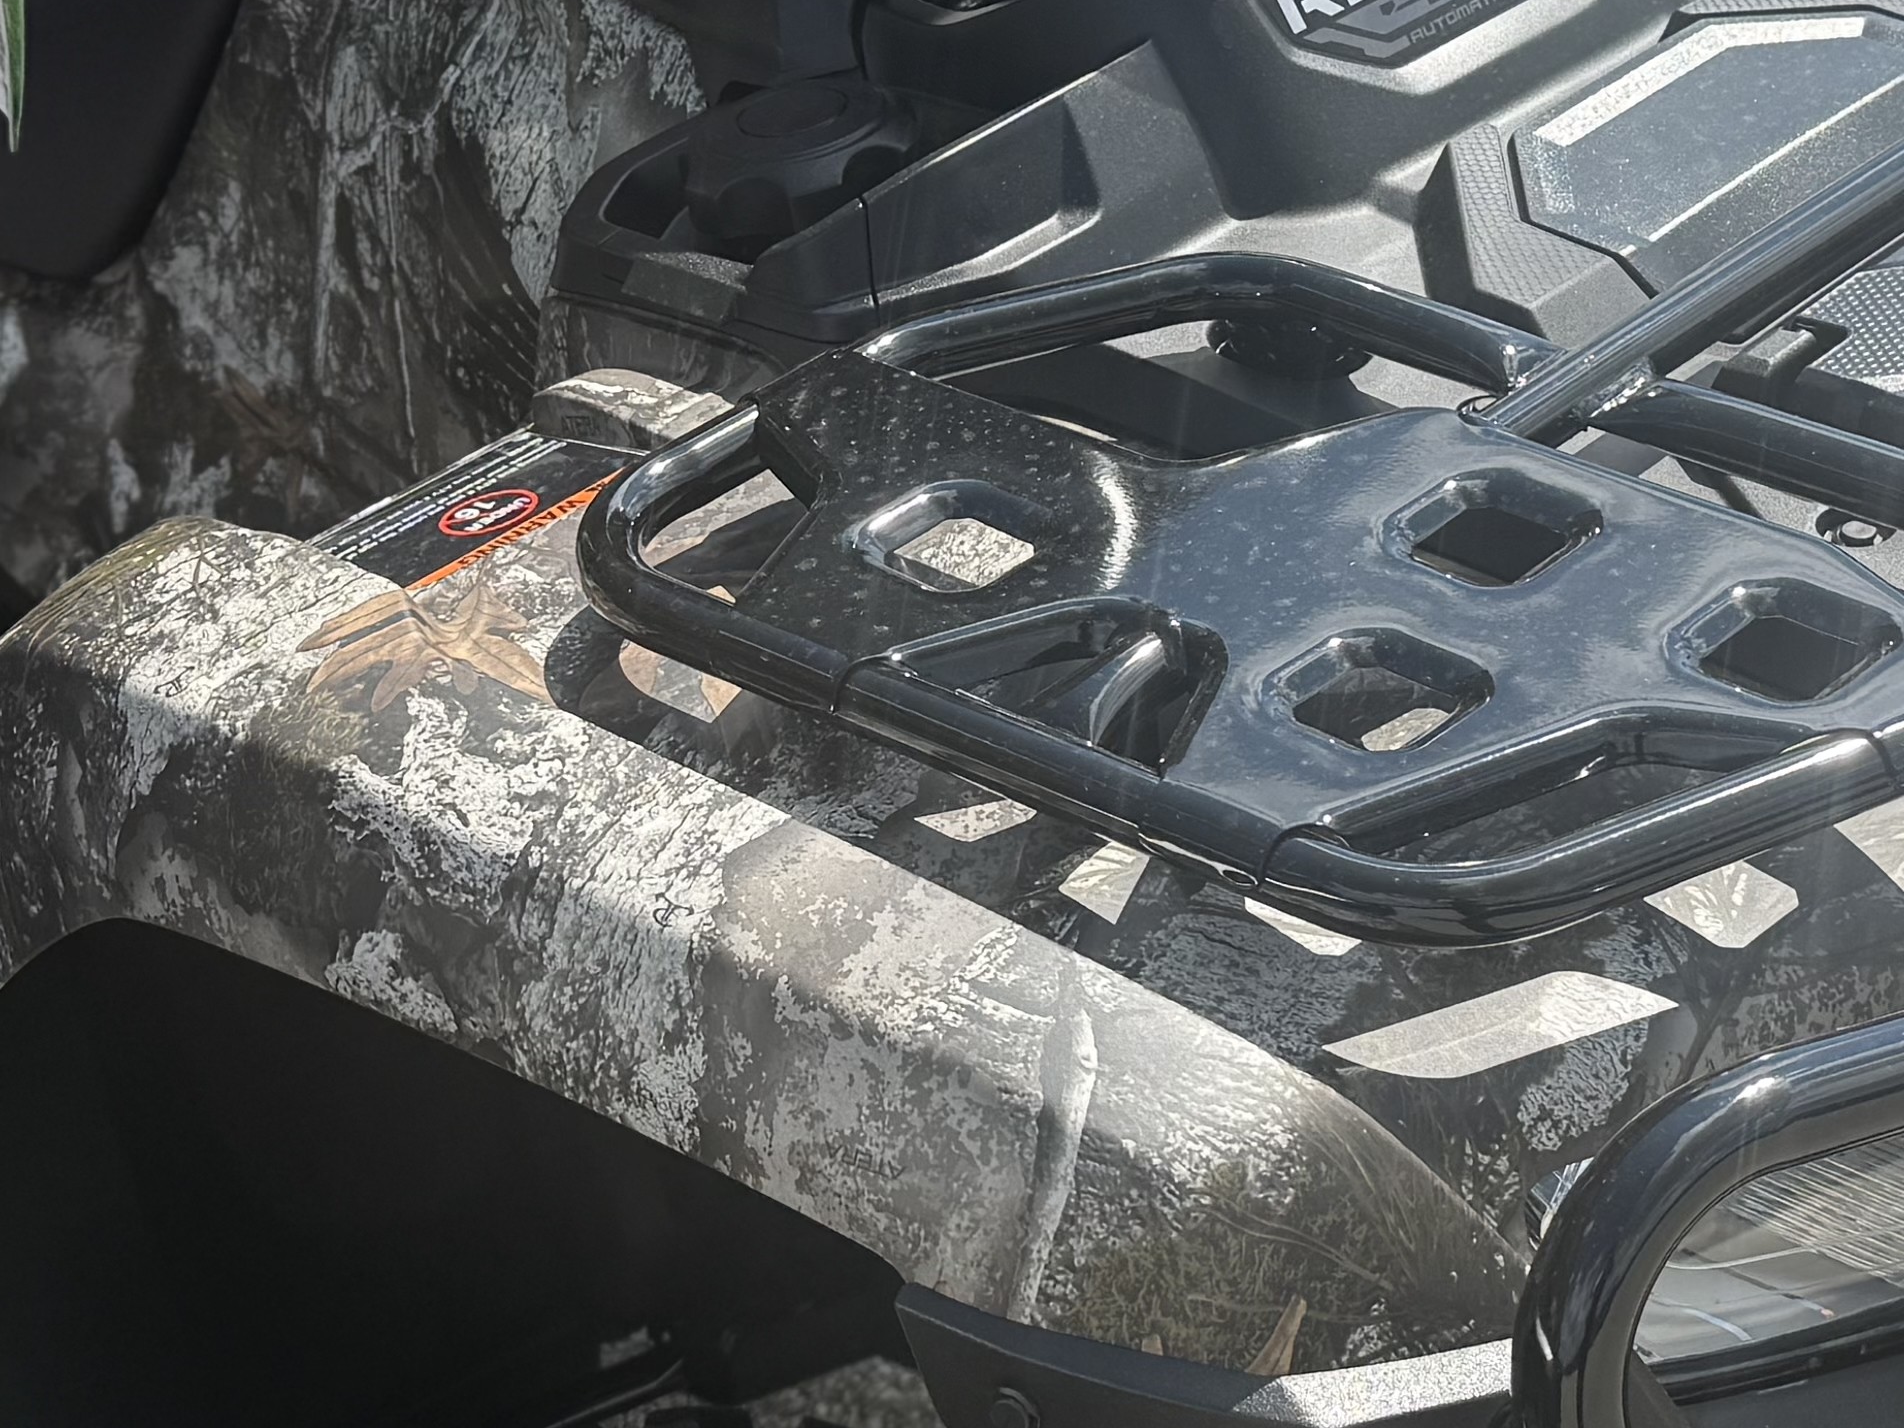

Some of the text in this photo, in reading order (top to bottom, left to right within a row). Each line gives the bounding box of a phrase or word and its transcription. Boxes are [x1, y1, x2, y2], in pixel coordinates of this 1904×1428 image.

[454, 500, 496, 520] 16
[464, 496, 532, 532] UNDER
[824, 1139, 906, 1180] ATERA
